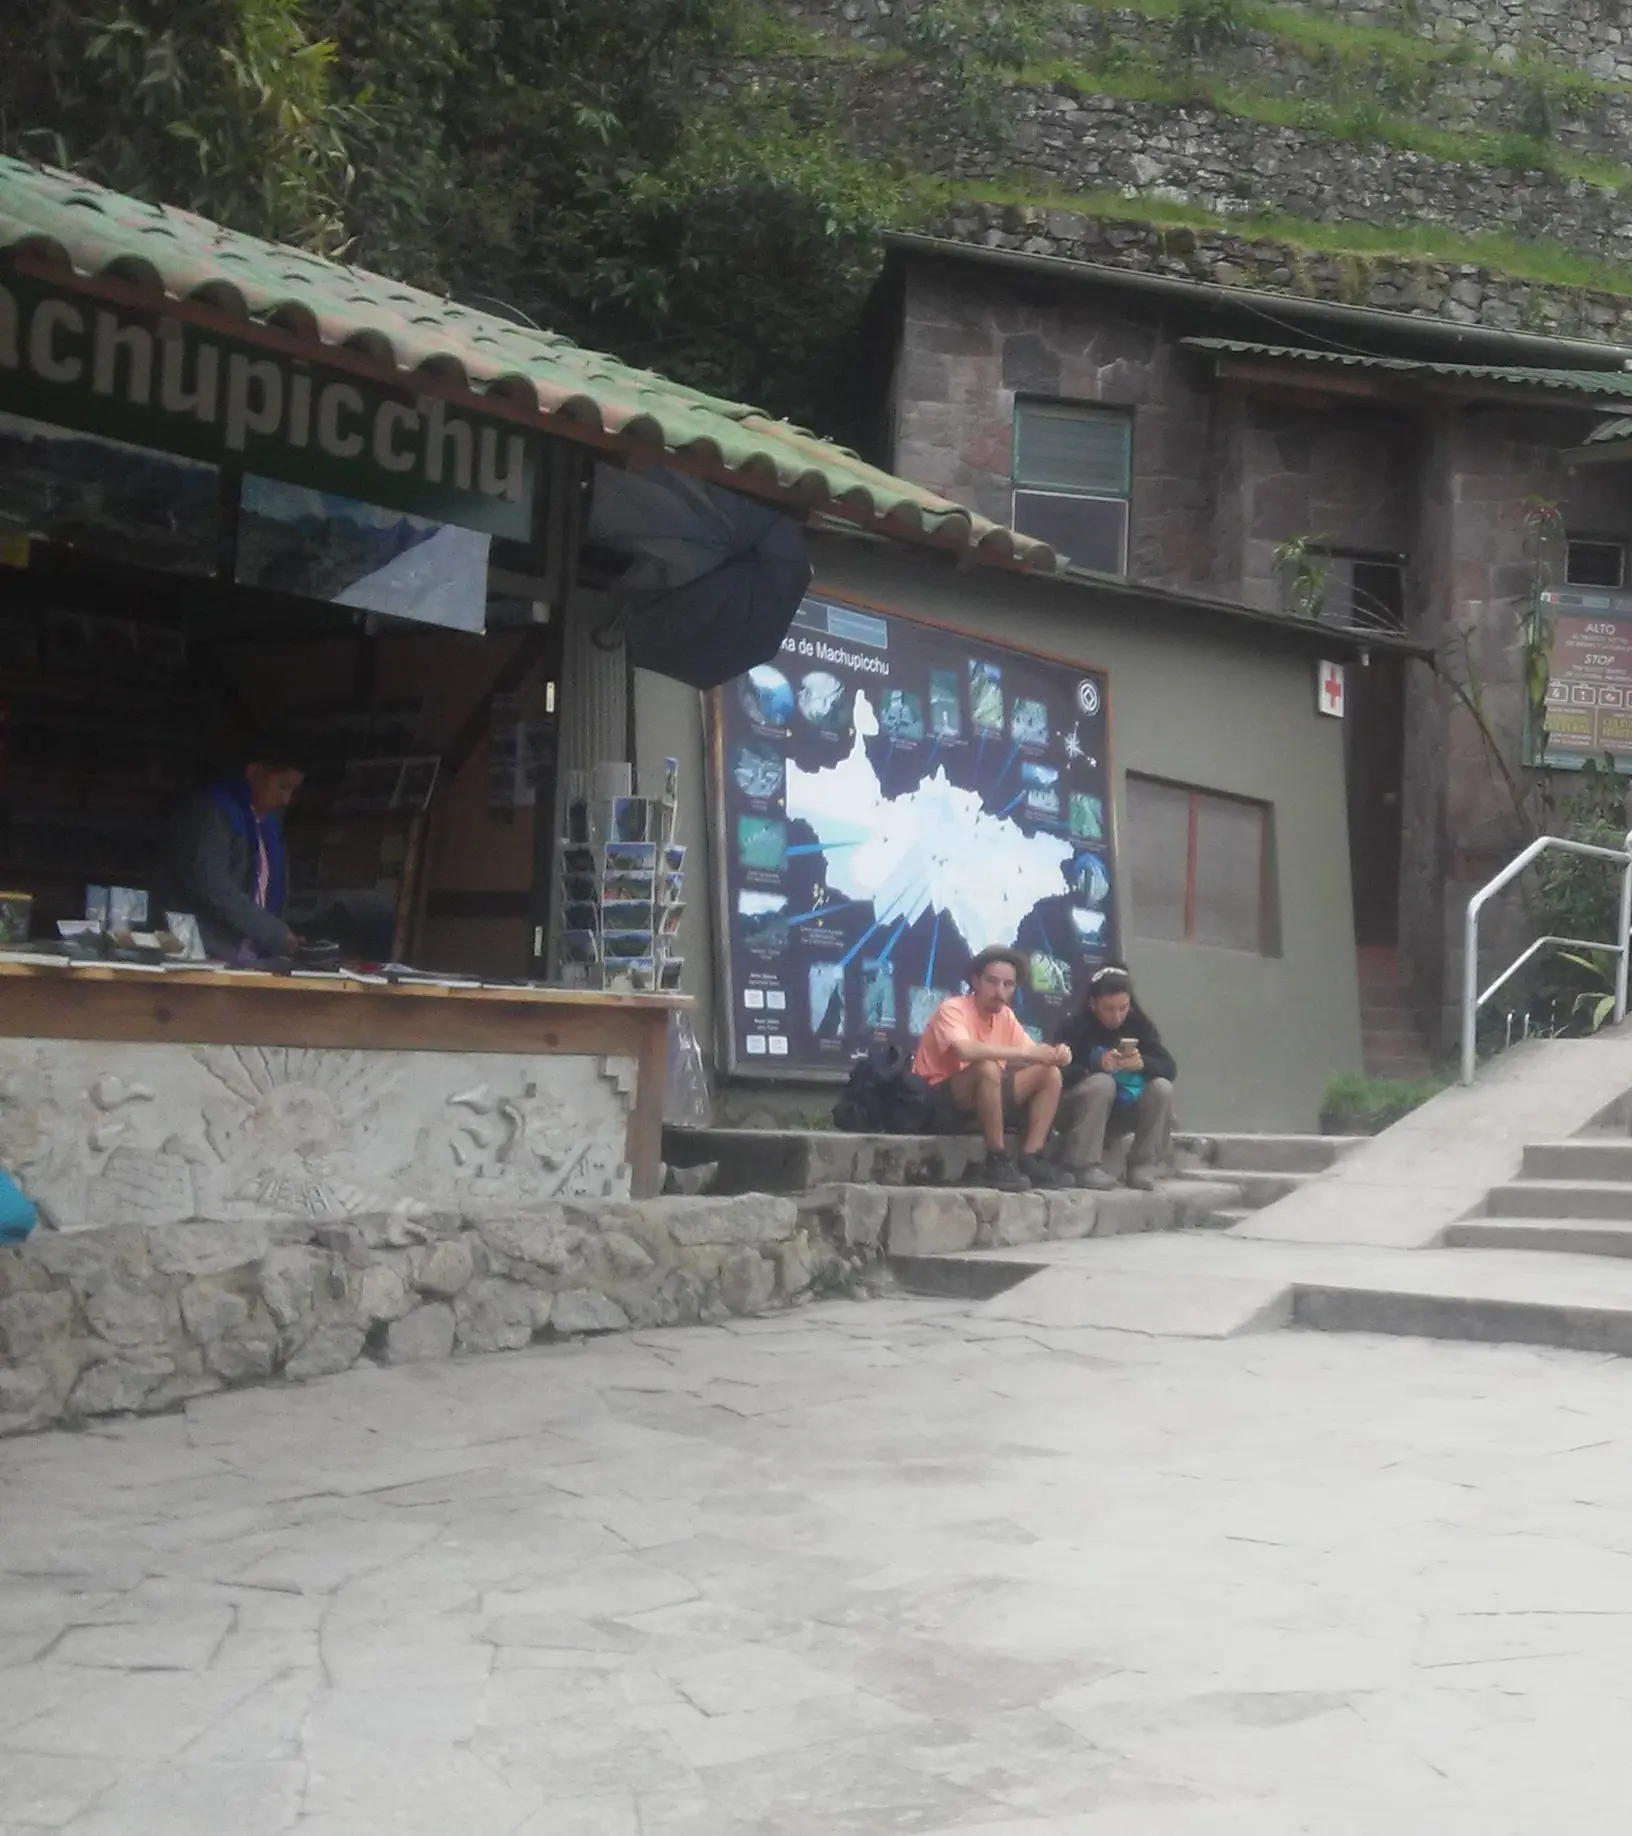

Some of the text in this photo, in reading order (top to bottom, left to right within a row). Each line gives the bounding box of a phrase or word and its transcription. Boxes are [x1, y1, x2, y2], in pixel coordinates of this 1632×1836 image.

[1585, 623, 1616, 635] ALTO
[798, 640, 814, 656] de
[816, 641, 889, 675] Machupicchu
[1584, 654, 1615, 665] STOP
